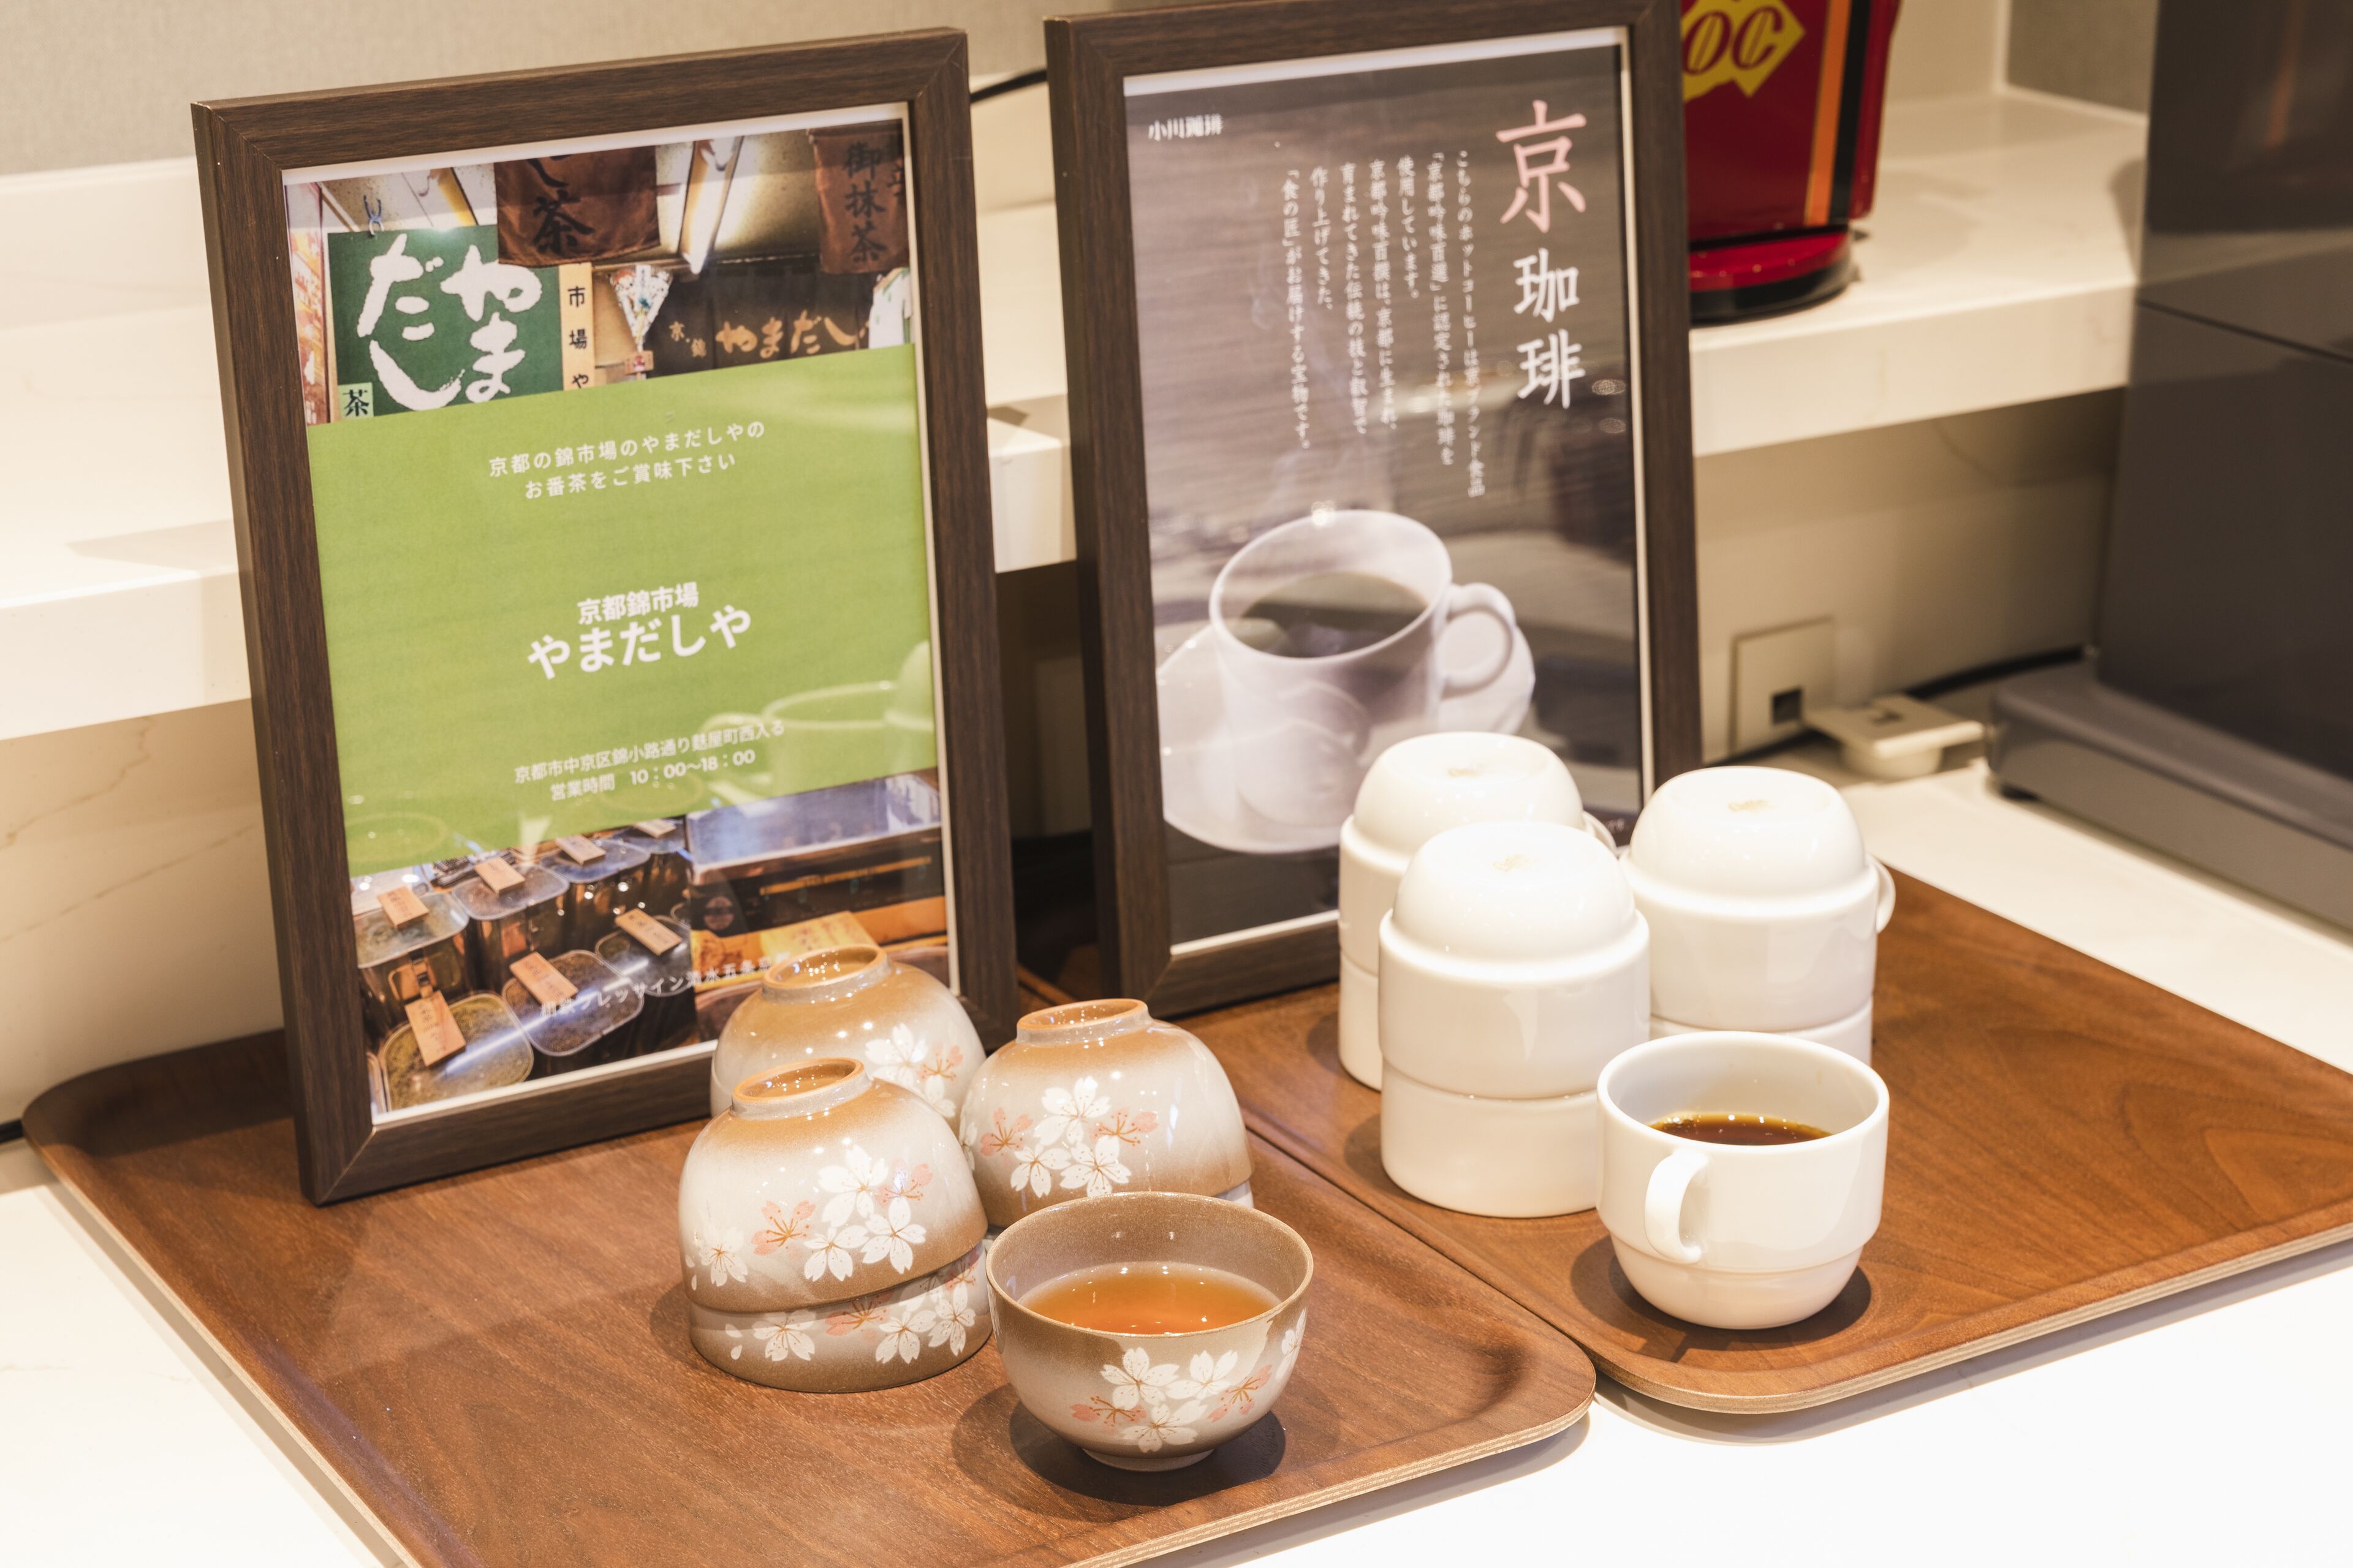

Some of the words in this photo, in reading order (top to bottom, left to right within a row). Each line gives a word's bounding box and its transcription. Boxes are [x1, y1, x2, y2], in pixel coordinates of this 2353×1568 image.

[844, 141, 887, 263] 御抹茶
[1396, 154, 1420, 300] 使用しています。
[1495, 99, 1587, 410] 京珈琲
[356, 233, 466, 411] だし
[440, 244, 543, 403] やま
[567, 286, 589, 388] 市場や
[715, 309, 869, 359] やまだし
[342, 387, 370, 417] 茶
[488, 421, 765, 477] 京都の錦市場のやまだしやの
[525, 453, 735, 499] お番茶をご賞味下さい
[577, 581, 699, 625] 京都錦市場
[527, 604, 752, 680] やまだしや
[550, 773, 616, 801] 営業時間
